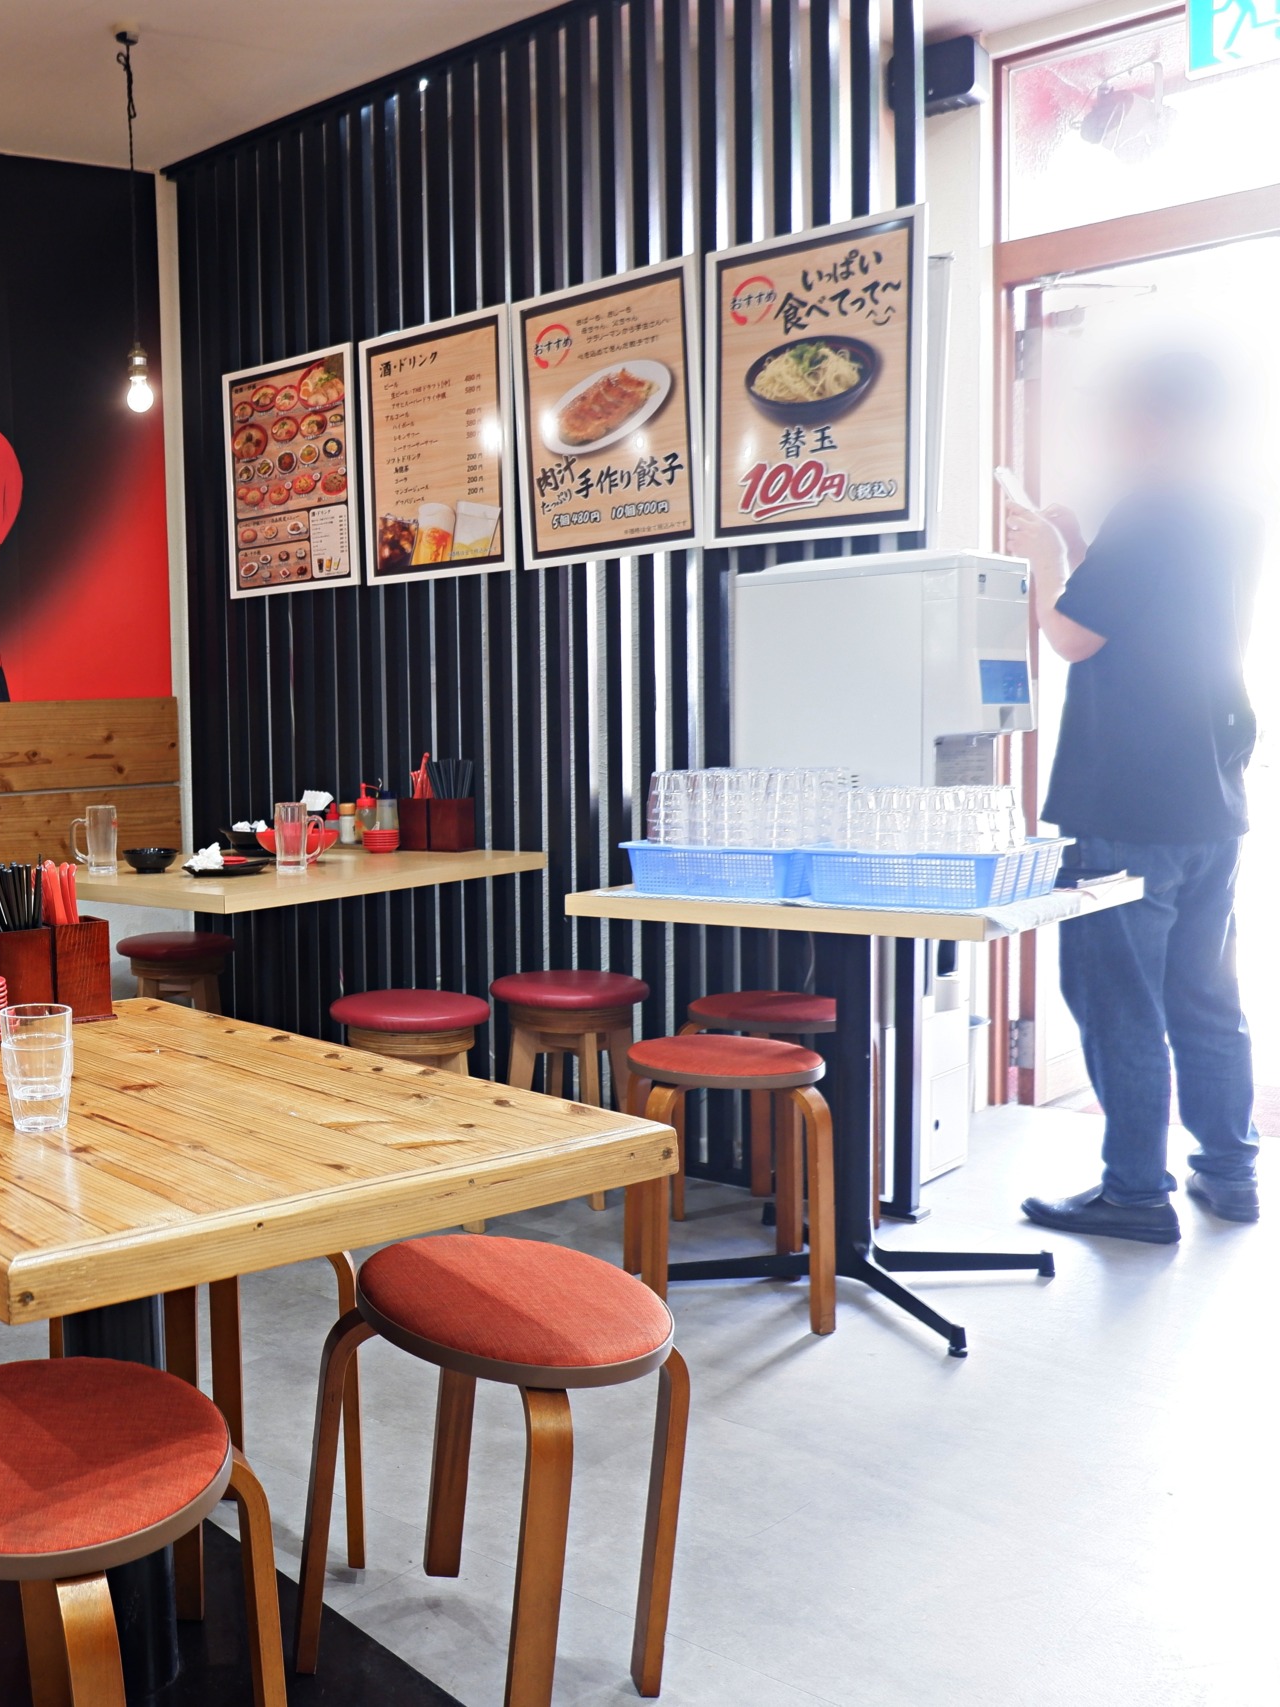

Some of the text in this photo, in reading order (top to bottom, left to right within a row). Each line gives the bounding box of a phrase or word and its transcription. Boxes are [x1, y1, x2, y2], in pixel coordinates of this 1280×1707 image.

[801, 249, 884, 292] いっぱい
[729, 288, 777, 311] おすすめ
[534, 337, 573, 357] おすすめ
[778, 425, 839, 459] 替玉
[535, 455, 577, 498] 肉汁
[574, 452, 684, 499] 手作り餃子
[541, 488, 573, 515] たっぷり
